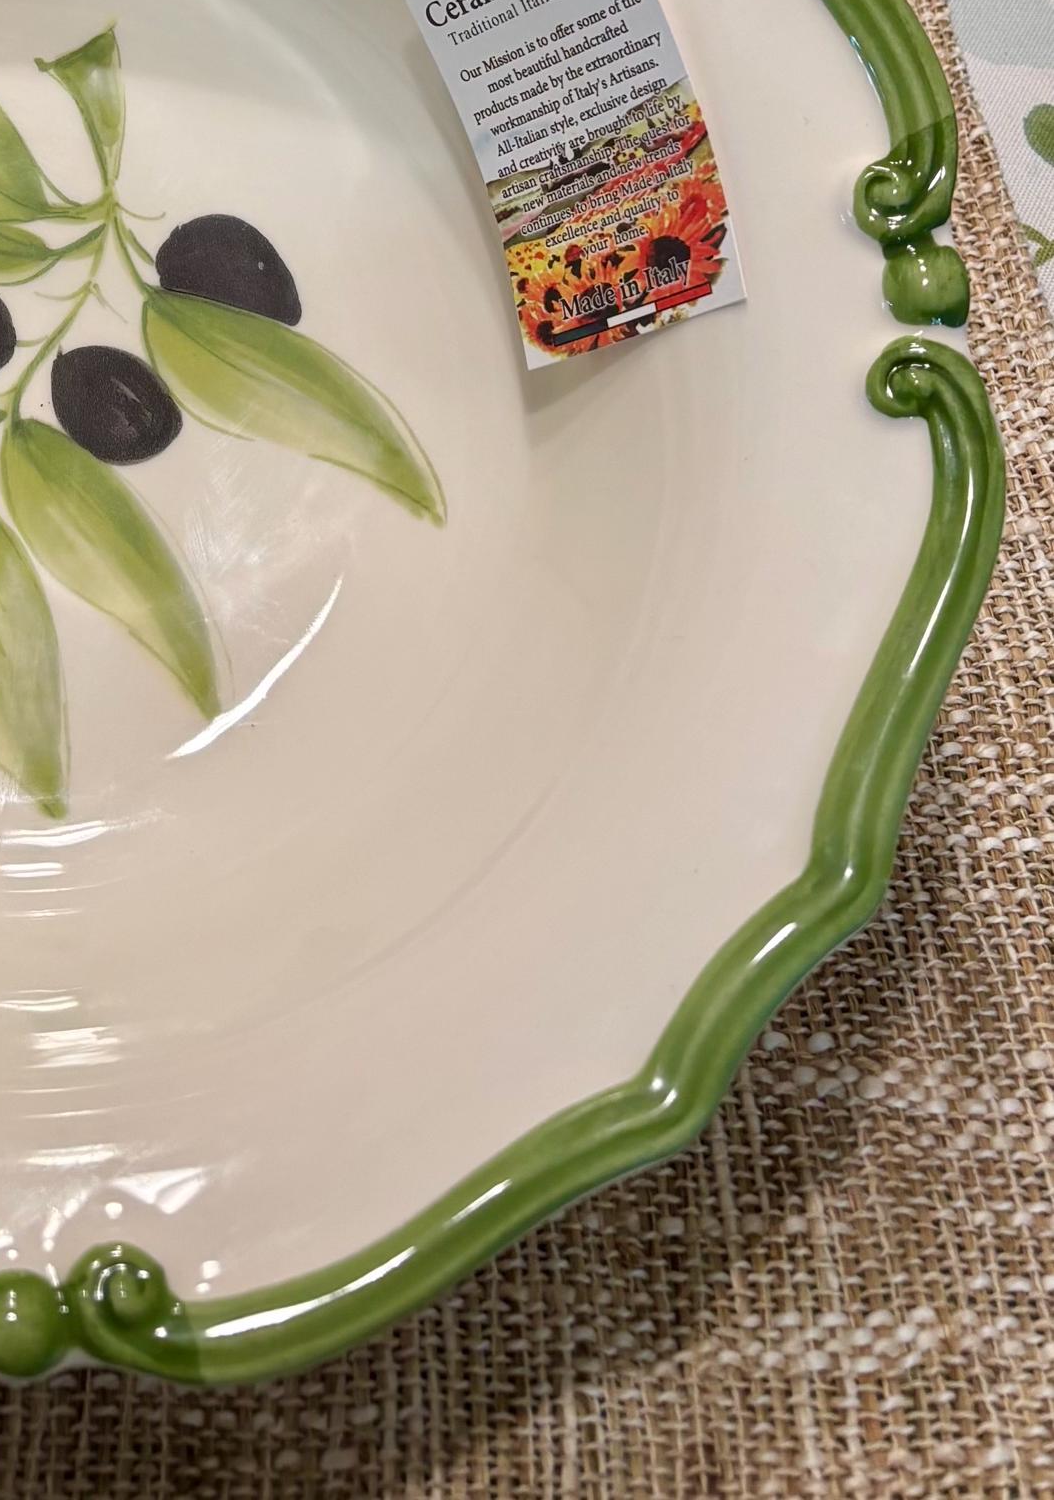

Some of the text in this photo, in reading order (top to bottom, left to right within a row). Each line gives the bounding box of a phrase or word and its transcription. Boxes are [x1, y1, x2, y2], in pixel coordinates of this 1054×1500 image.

[448, 4, 519, 45] Traditional
[460, 66, 482, 82] Our
[484, 48, 525, 72] Mission
[526, 41, 536, 53] is
[536, 36, 548, 47] to
[550, 23, 575, 41] offer
[576, 9, 606, 29] some
[608, 0, 623, 15] of
[488, 20, 629, 93] most beautiful handcrafted
[474, 31, 661, 125] products made by the extraordinary
[490, 57, 659, 137] workmanship of Italy's Artisans.
[497, 77, 667, 157] All-Italian style, exclusive design
[499, 94, 681, 178] and creativity are brought to life by
[502, 113, 691, 199] artisan craftsmanship. The quest for
[523, 141, 681, 212] new materials and new trends
[521, 159, 694, 235] continues, to bring Made in Italy
[546, 189, 679, 248] excellence and quality to
[583, 225, 648, 258] your home.
[560, 256, 690, 320] Made in Italy
